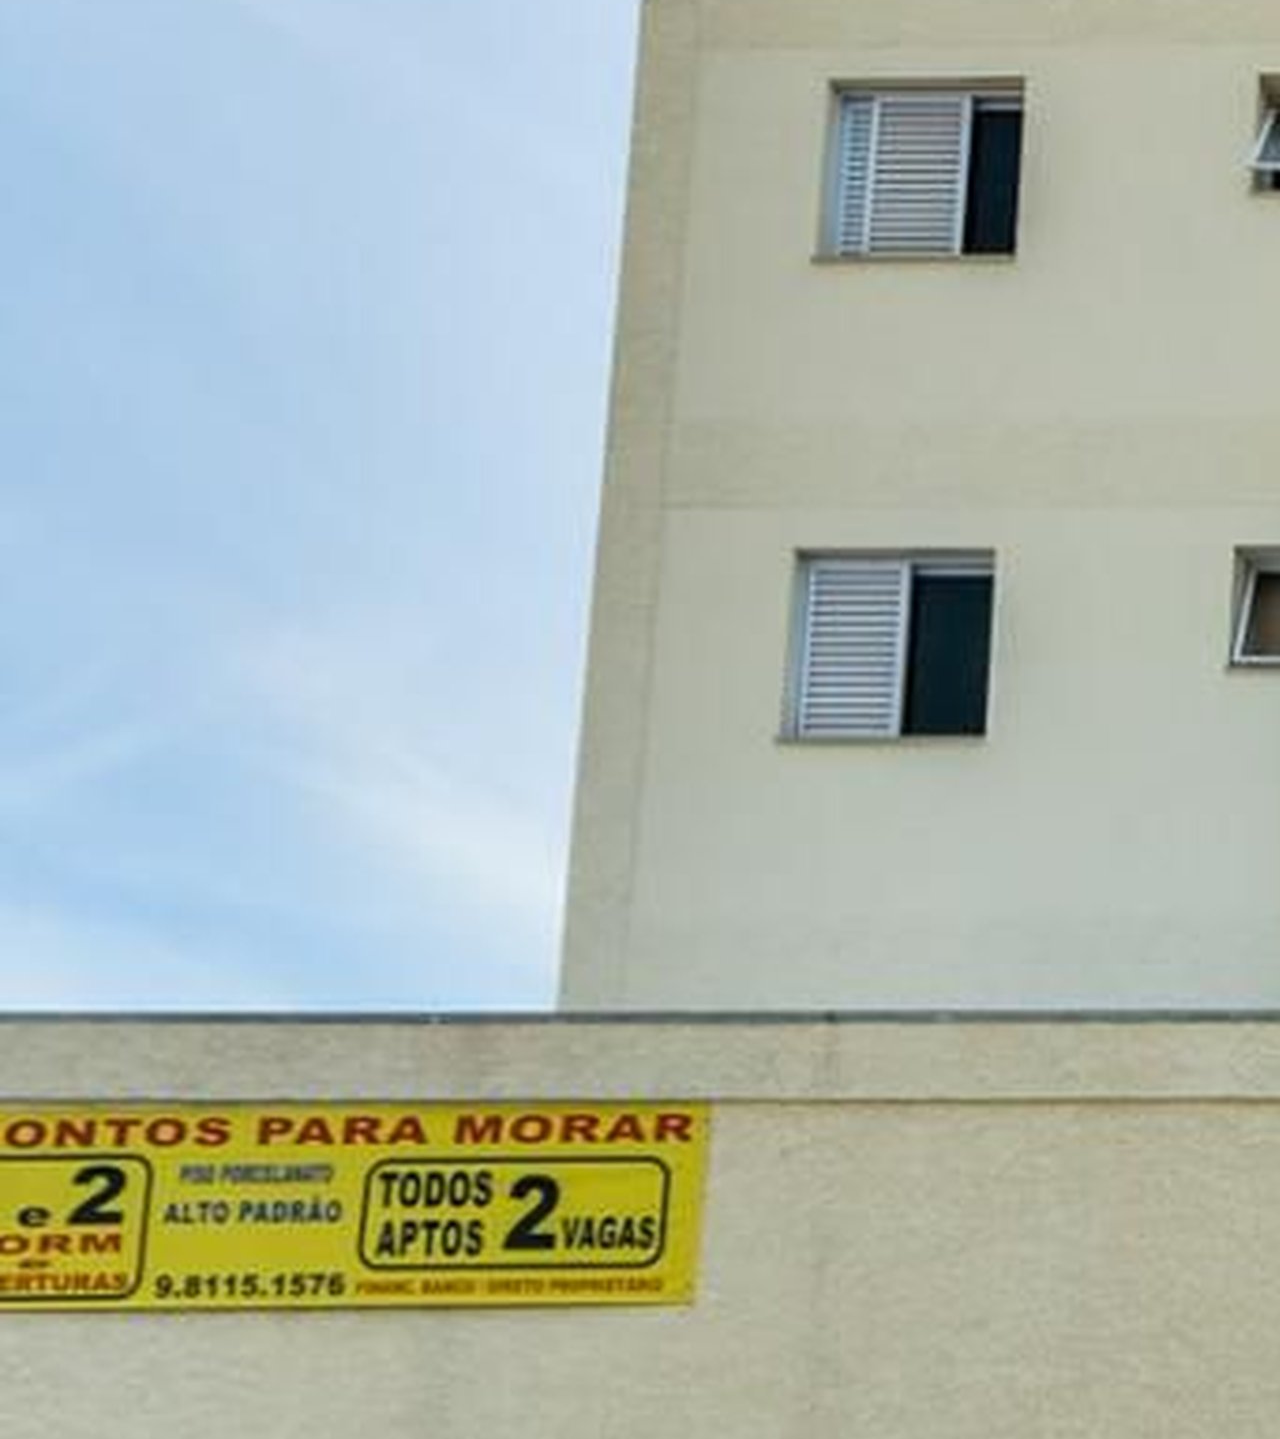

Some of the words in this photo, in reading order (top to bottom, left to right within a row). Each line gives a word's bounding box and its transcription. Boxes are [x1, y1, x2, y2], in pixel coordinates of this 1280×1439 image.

[257, 1117, 428, 1146] PARA
[453, 1114, 692, 1145] MORAR
[18, 1207, 51, 1227] e
[68, 1165, 127, 1224] 2
[378, 1170, 494, 1207] TODOS
[164, 1202, 230, 1224] ALTO
[502, 1174, 560, 1250] 2
[562, 1216, 655, 1250] VAGAS
[376, 1221, 484, 1257] APTOS
